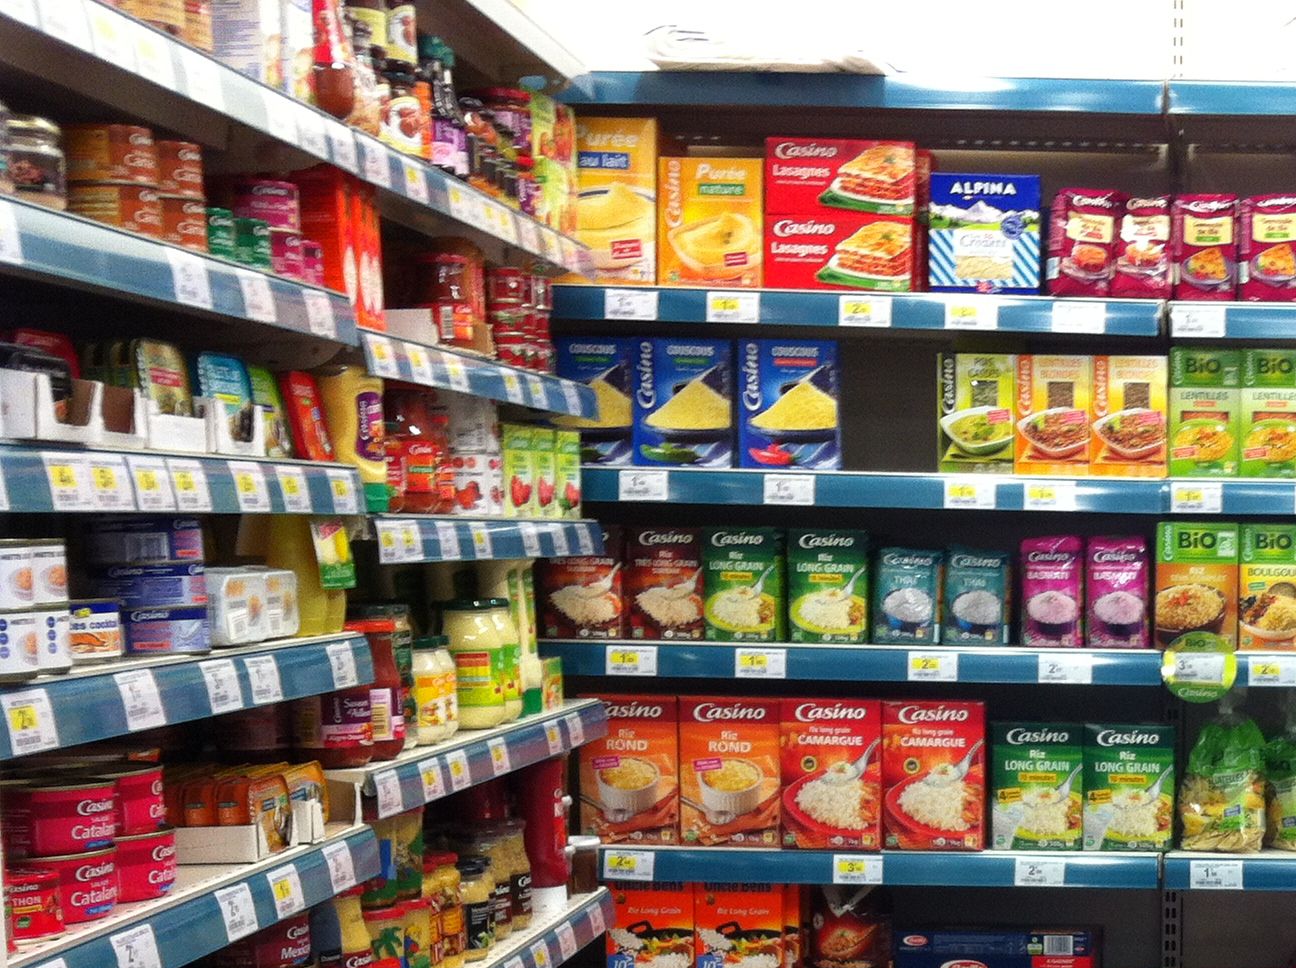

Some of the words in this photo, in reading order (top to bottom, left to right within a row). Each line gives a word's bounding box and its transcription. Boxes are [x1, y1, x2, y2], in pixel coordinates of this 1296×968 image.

[775, 142, 838, 159] Casino
[772, 164, 830, 179] Lasagnes
[950, 182, 1017, 196] ALPINA
[773, 220, 835, 237] Casino
[771, 242, 828, 256] Lasagnes
[637, 341, 656, 409] Casino
[743, 342, 762, 411] Casino
[639, 530, 694, 546] Casino
[711, 531, 763, 547] Casino
[798, 533, 854, 549] Casino
[1178, 531, 1217, 550] BiO
[1255, 533, 1292, 550] BiO
[884, 553, 933, 568] Casino
[952, 554, 1000, 569] Casino
[1028, 552, 1069, 563] Casino
[1093, 551, 1136, 563] Casino
[693, 703, 766, 721] Casino
[795, 703, 867, 720] Casino
[898, 705, 969, 724] Casino
[797, 734, 863, 746] CAMARGUE
[900, 736, 965, 748] CAMARGUE
[1006, 728, 1069, 745] Casino
[1096, 730, 1159, 747] Casino
[606, 739, 648, 751] ROND
[709, 741, 751, 753] ROND
[1004, 761, 1033, 771] LONG
[1035, 761, 1070, 772] GRAIN
[1095, 762, 1123, 772] LONG
[1125, 762, 1160, 773] GRAIN
[71, 824, 116, 840] Catalan
[70, 886, 118, 906] Catalan
